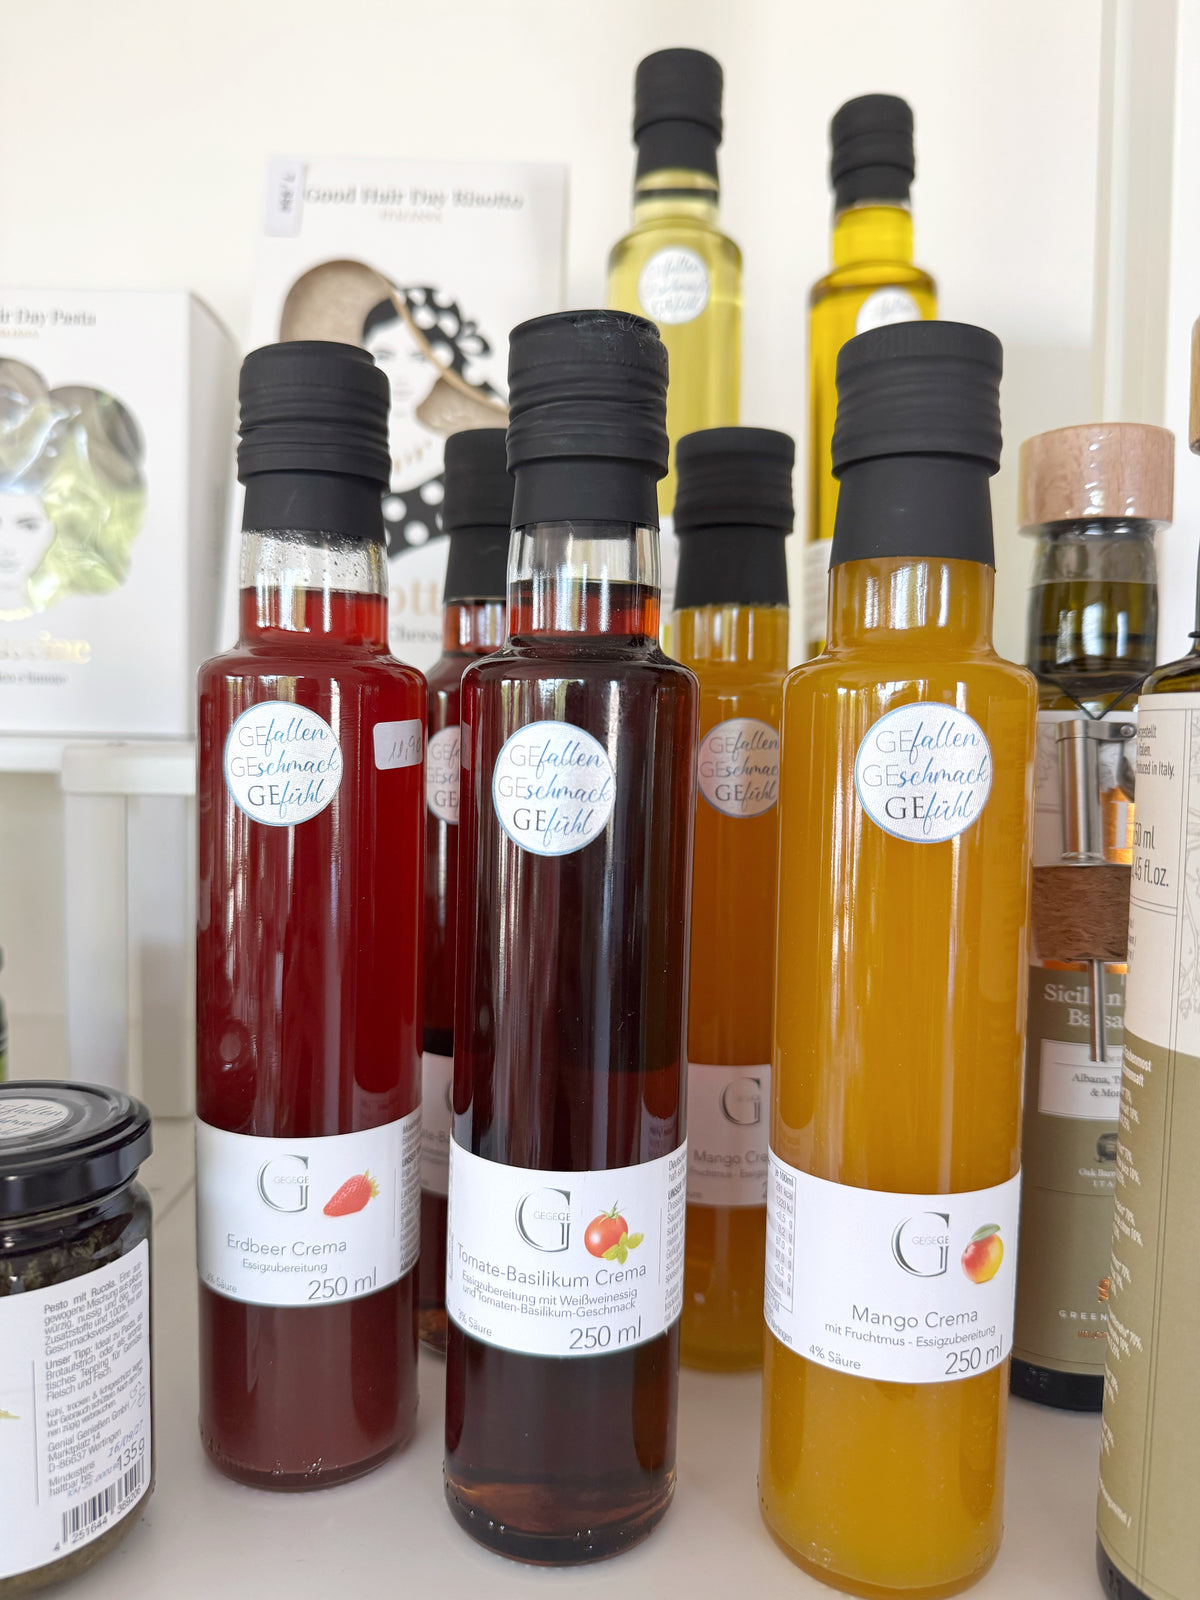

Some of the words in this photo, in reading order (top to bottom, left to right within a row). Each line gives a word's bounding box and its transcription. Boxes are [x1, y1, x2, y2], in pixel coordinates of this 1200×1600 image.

[238, 718, 328, 757] GEfallen
[875, 721, 981, 765] GEfallen
[230, 747, 340, 778] GEschmack
[510, 739, 606, 780] GEfallen
[700, 755, 779, 778] GEschmac
[862, 754, 990, 788] GEschmack
[1159, 761, 1175, 781] Italy.
[247, 779, 325, 819] GEfühl
[498, 774, 612, 804] GEschmack
[513, 807, 594, 848] GEfühl
[885, 790, 975, 836] GEfühl
[1132, 822, 1142, 847] 50
[1143, 825, 1155, 850] ml
[1144, 858, 1169, 887] fl.oz.
[1044, 984, 1121, 1006] Siciln
[745, 1150, 768, 1164] Cre
[227, 1233, 287, 1256] Erdbeer
[292, 1241, 347, 1257] Crema
[242, 1258, 328, 1274] Essigzubereitung
[457, 1242, 589, 1288] Tomate-Basilikum
[595, 1264, 647, 1287] Crema
[308, 1276, 348, 1301] 250
[354, 1266, 377, 1292] ml
[462, 1270, 537, 1306] Essigzubereitung
[538, 1291, 557, 1306] mit
[559, 1287, 638, 1307] Weißweinessig
[44, 1300, 69, 1315] Pesto
[73, 1292, 87, 1305] mit
[44, 1303, 86, 1327] gewogene
[87, 1287, 118, 1310] Mischung
[77, 1307, 102, 1325] nussig
[104, 1297, 117, 1312] und
[462, 1285, 476, 1299] und
[476, 1290, 636, 1318] Tomaten-Basilikum-Geschmack
[45, 1321, 93, 1346] Zusatzstoffe
[94, 1313, 108, 1327] und
[109, 1303, 126, 1320] 100%
[468, 1316, 492, 1337] Säure
[569, 1325, 611, 1350] 250
[618, 1315, 642, 1344] ml
[852, 1304, 918, 1332] Mango
[925, 1309, 978, 1328] Crema
[825, 1322, 842, 1336] mit
[845, 1326, 906, 1347] Fruchtmus
[916, 1325, 996, 1350] Essigzubereitung
[46, 1355, 71, 1371] Unser
[74, 1345, 93, 1360] Tipp:
[46, 1355, 96, 1381] Brotaufstrich
[100, 1343, 115, 1359] oder
[809, 1344, 825, 1360] 4%
[828, 1350, 861, 1370] Säure
[945, 1347, 981, 1375] 250
[986, 1334, 1003, 1365] ml
[46, 1373, 77, 1391] tisches
[81, 1358, 109, 1378] Topping
[47, 1383, 76, 1402] Fleisch
[77, 1376, 92, 1391] und
[48, 1433, 75, 1452] Genial
[111, 1402, 130, 1421] GmbH
[48, 1438, 91, 1462] Marktplatz
[48, 1461, 96, 1488] Mindestens
[53, 1541, 61, 1552] 4
[71, 1515, 108, 1545] 251644
